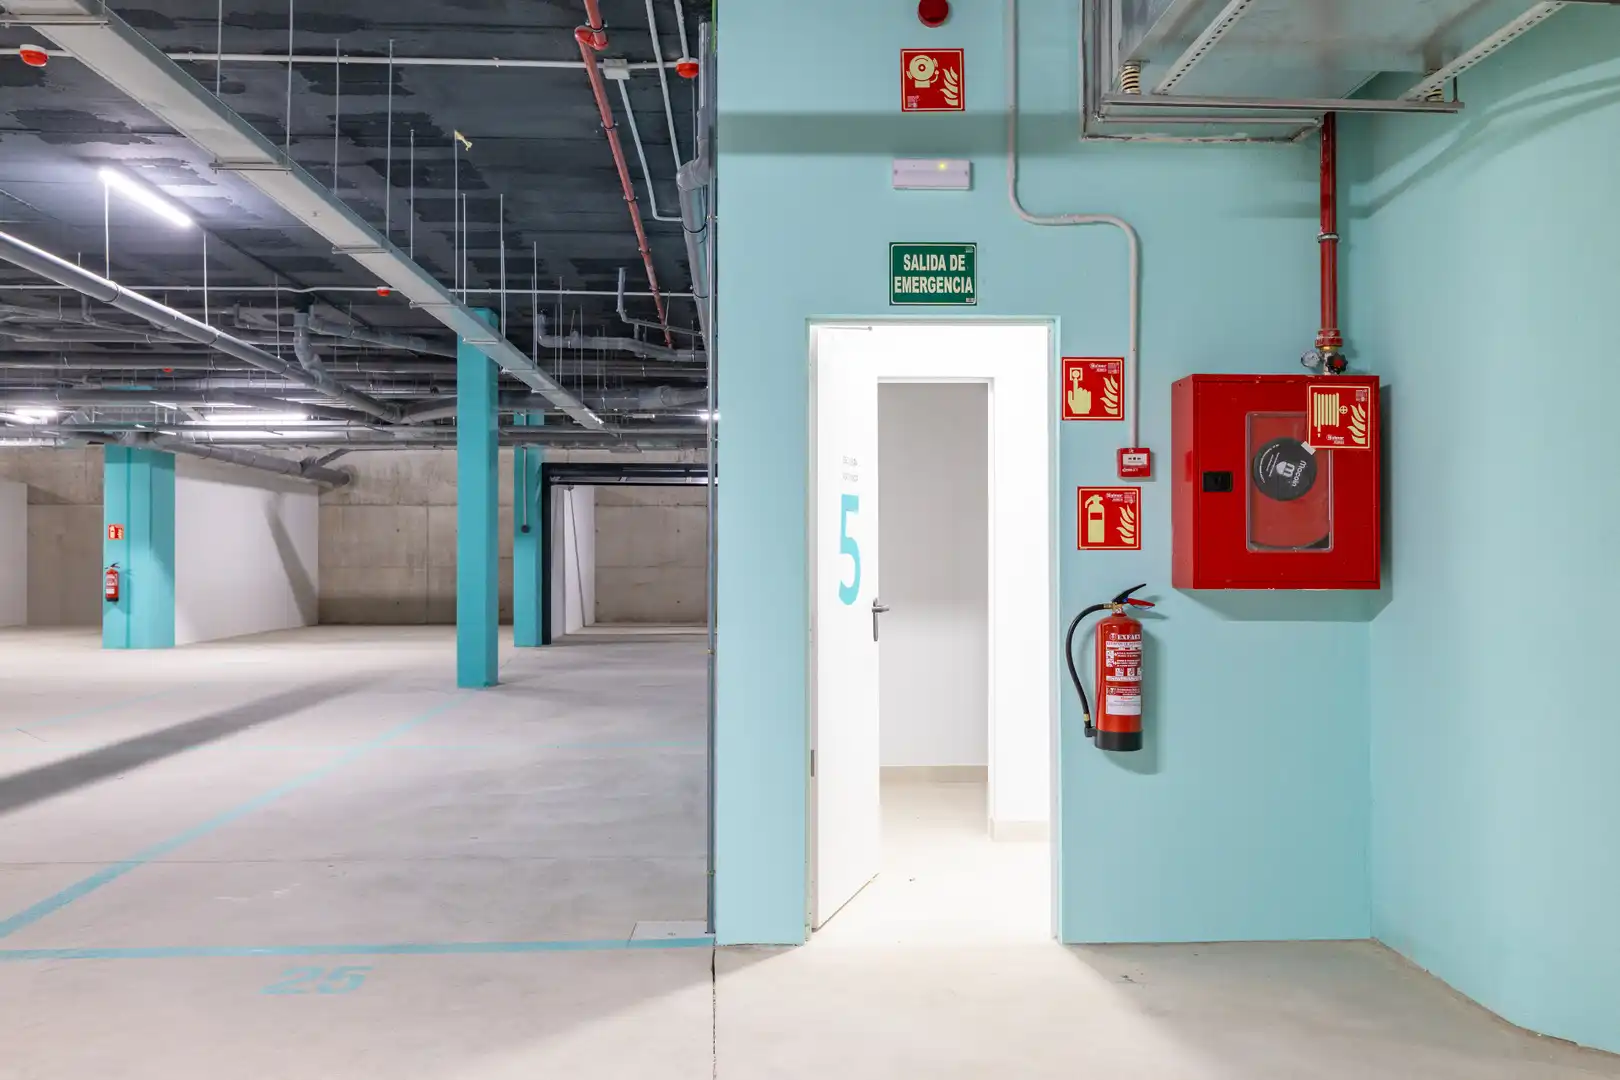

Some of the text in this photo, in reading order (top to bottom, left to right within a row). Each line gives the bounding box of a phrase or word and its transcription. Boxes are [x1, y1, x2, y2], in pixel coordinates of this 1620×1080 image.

[903, 253, 966, 271] SALIDA DE
[894, 275, 974, 293] EMERGENCIA
[838, 493, 861, 606] 5
[259, 965, 374, 995] 25
